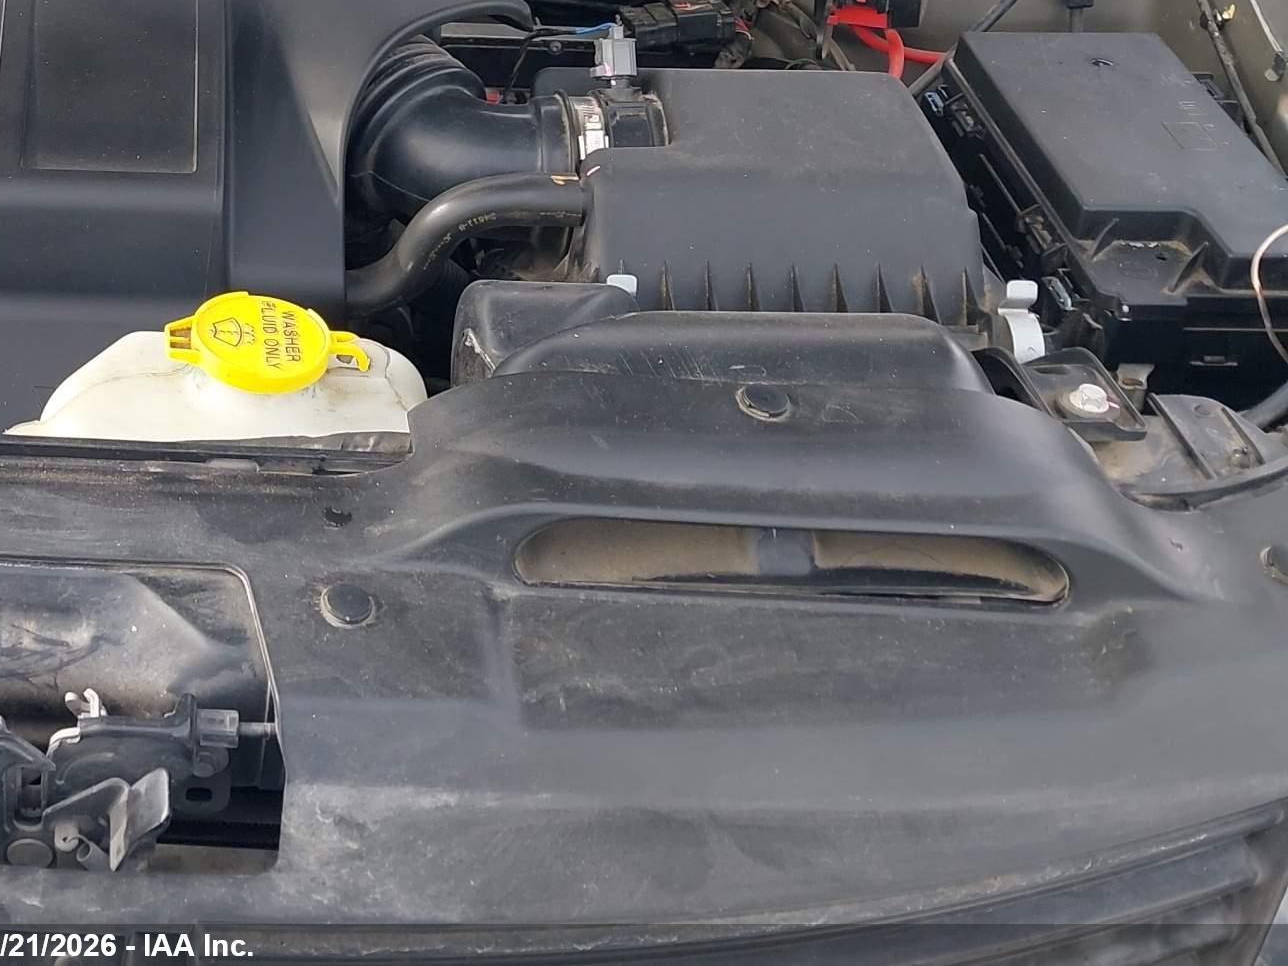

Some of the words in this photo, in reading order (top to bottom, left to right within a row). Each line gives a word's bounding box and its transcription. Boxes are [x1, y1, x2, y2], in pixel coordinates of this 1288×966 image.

[261, 300, 280, 336] FLUID
[263, 338, 282, 370] ONLY
[282, 310, 302, 363] WASHER
